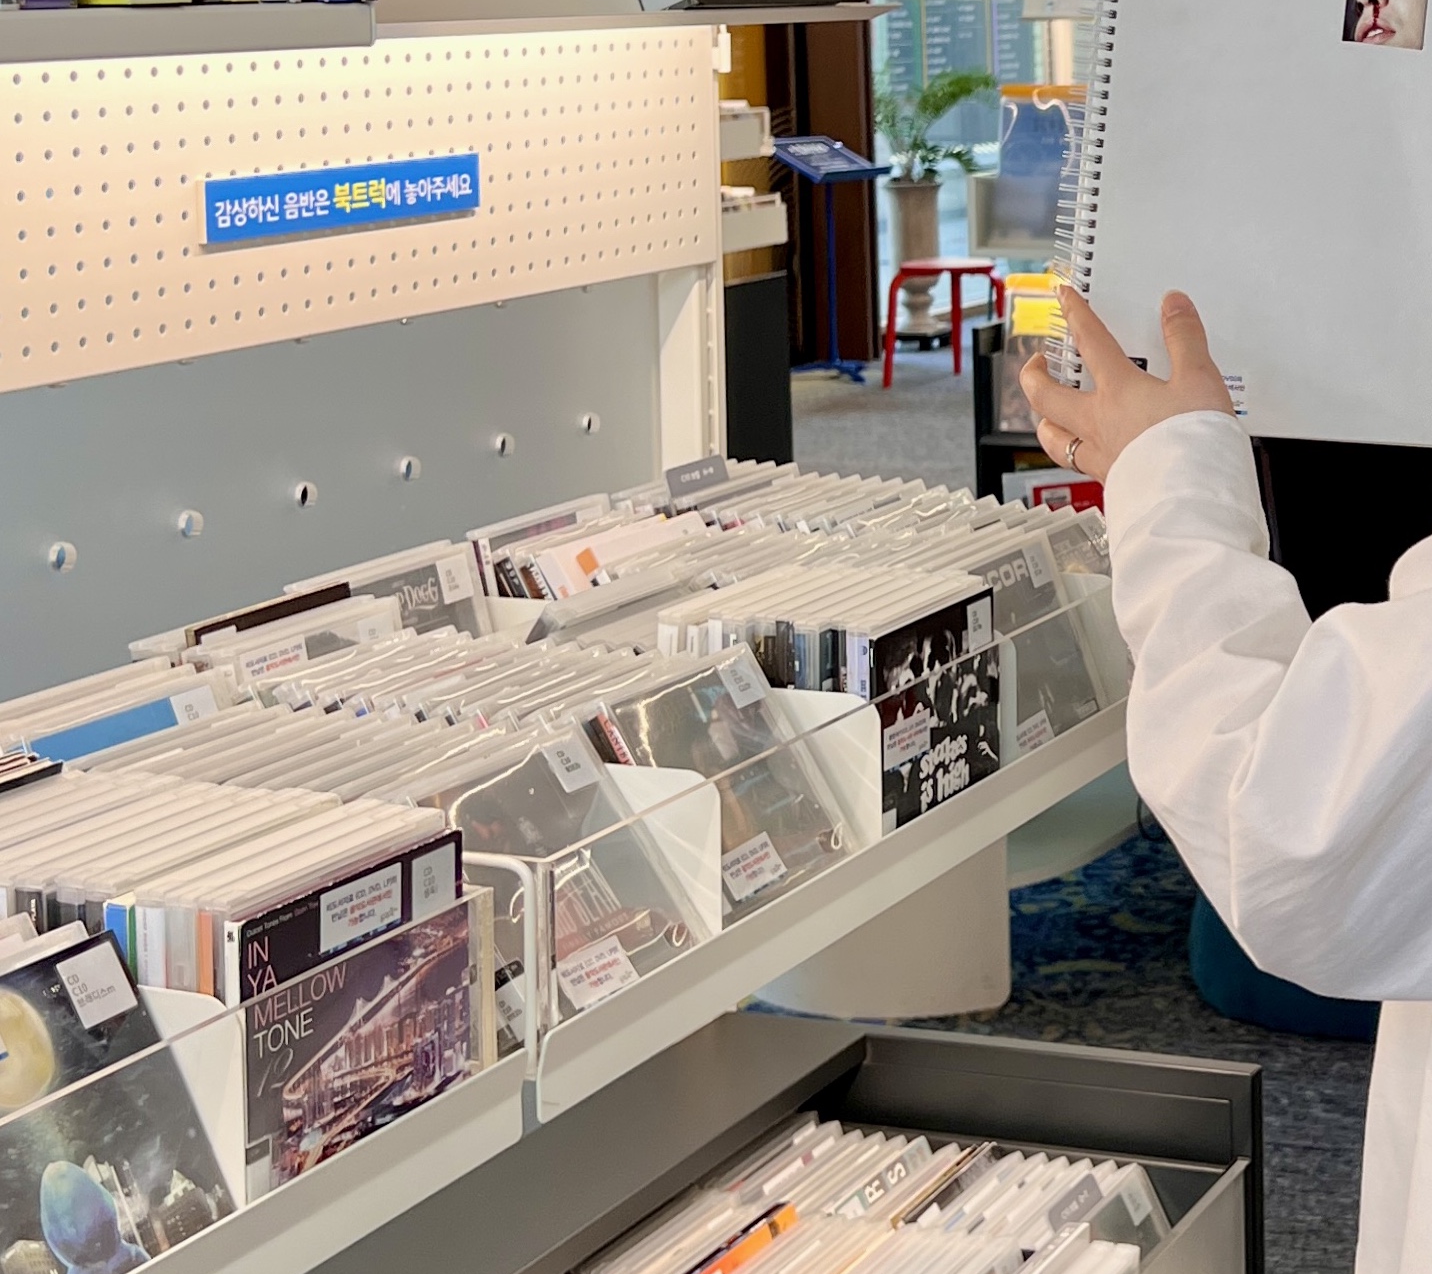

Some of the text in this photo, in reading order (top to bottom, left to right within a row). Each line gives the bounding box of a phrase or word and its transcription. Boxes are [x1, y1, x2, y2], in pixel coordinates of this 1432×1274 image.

[214, 173, 473, 229] 감상하신 음반은 북트럭에 놓아주세요
[247, 934, 269, 971] IN
[66, 973, 80, 986] CD
[71, 982, 88, 997] C10
[247, 964, 279, 1000] YA
[252, 962, 348, 1031] MELLOW
[253, 1006, 314, 1059] TONE
